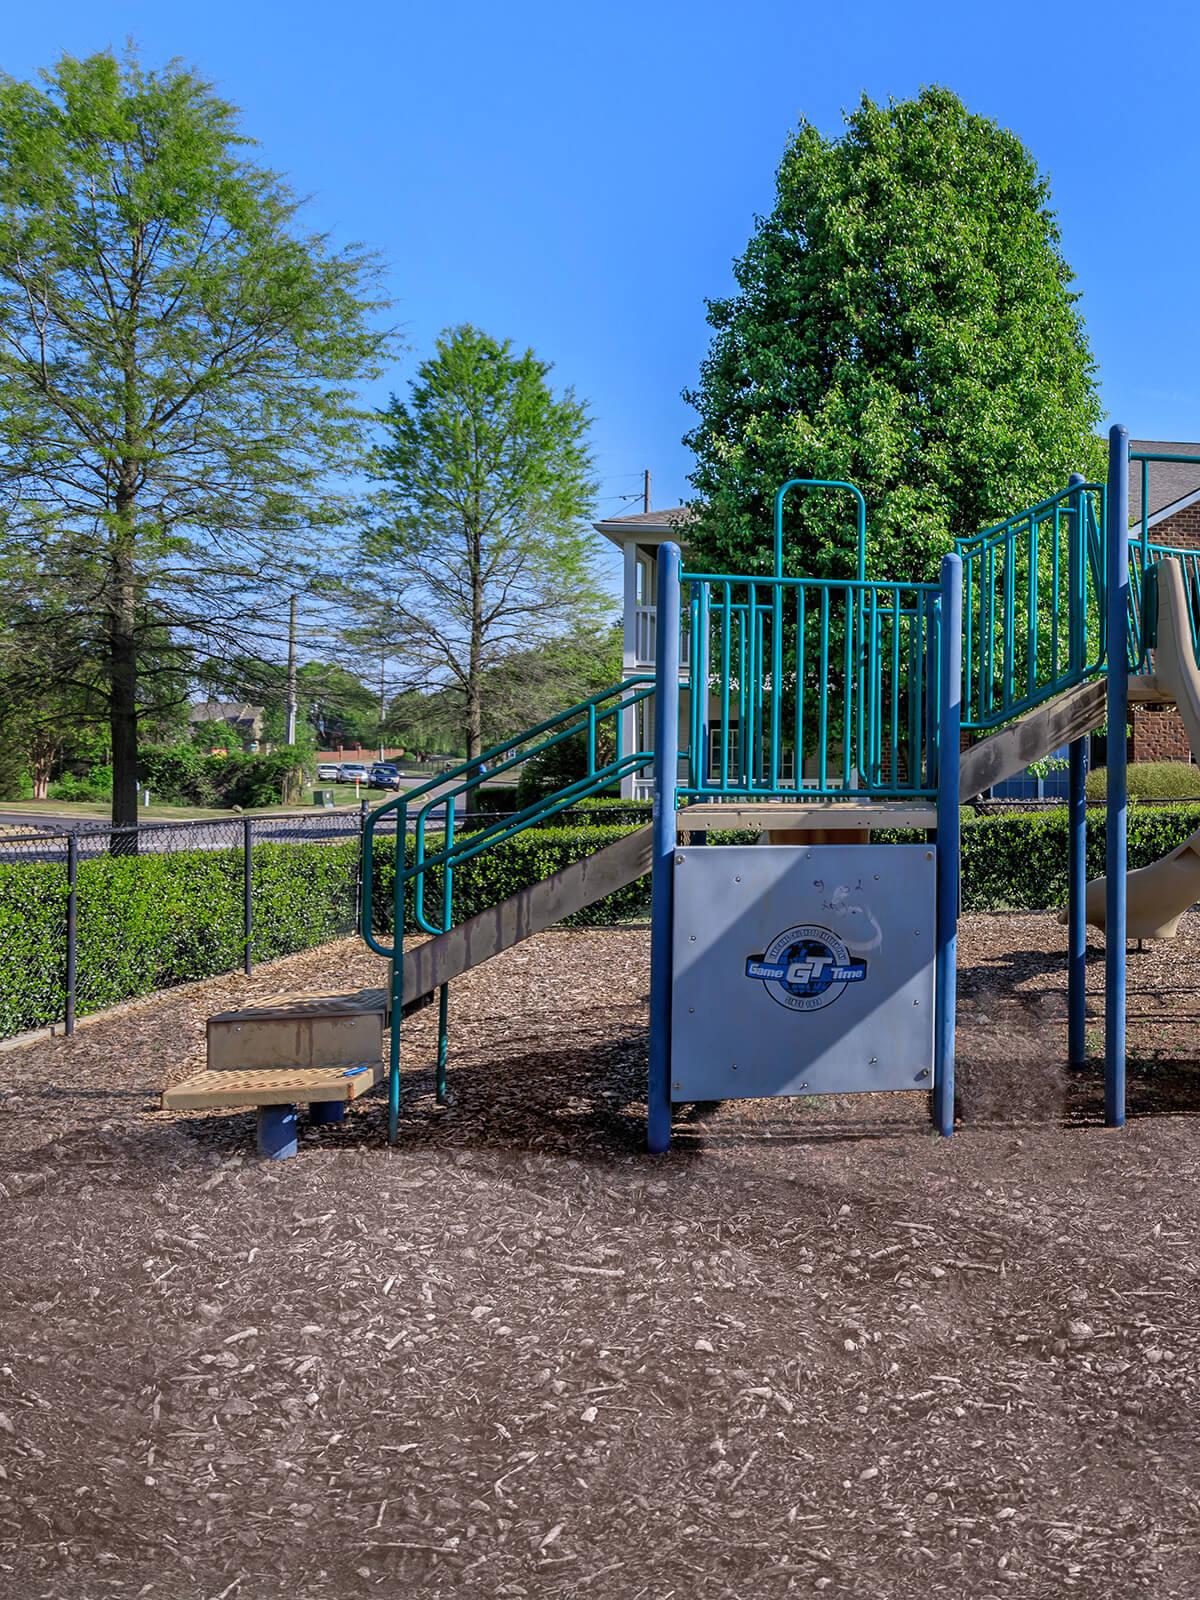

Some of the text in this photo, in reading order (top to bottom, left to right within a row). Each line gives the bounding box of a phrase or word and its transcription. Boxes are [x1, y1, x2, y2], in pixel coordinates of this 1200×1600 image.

[749, 956, 863, 984] Game GT Time
